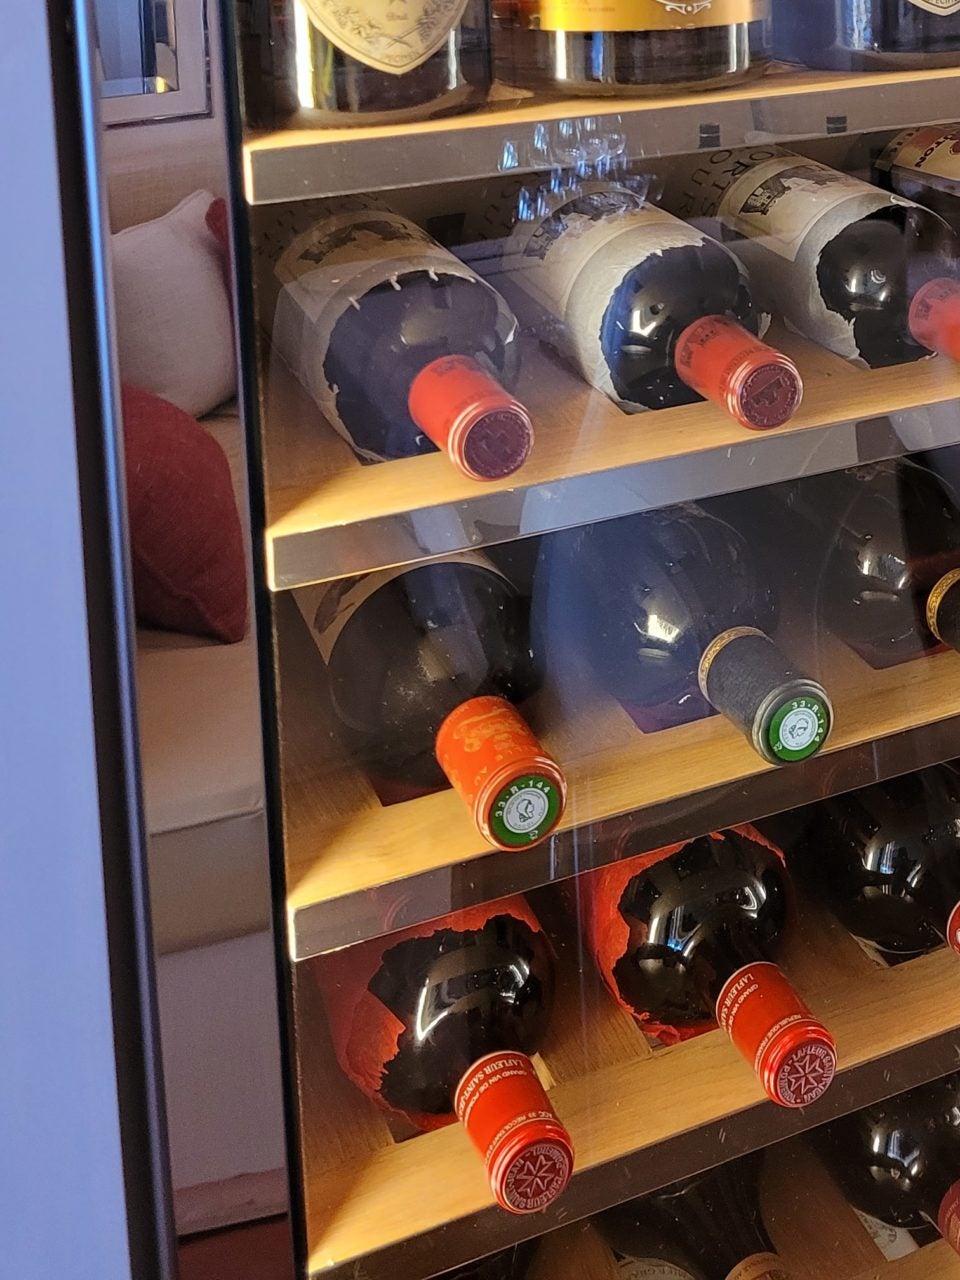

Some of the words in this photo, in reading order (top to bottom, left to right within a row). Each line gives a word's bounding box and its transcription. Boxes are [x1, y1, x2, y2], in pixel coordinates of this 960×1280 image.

[724, 972, 755, 1007] LAFLEUR
[737, 982, 760, 1004] GRAND
[731, 1003, 739, 1017] VIN
[791, 1044, 829, 1062] LAFLEUR
[486, 1058, 525, 1076] LAFLEUR
[479, 1083, 490, 1094] DE
[488, 1073, 503, 1087] VIN
[526, 1175, 562, 1210] LAFLEUR
